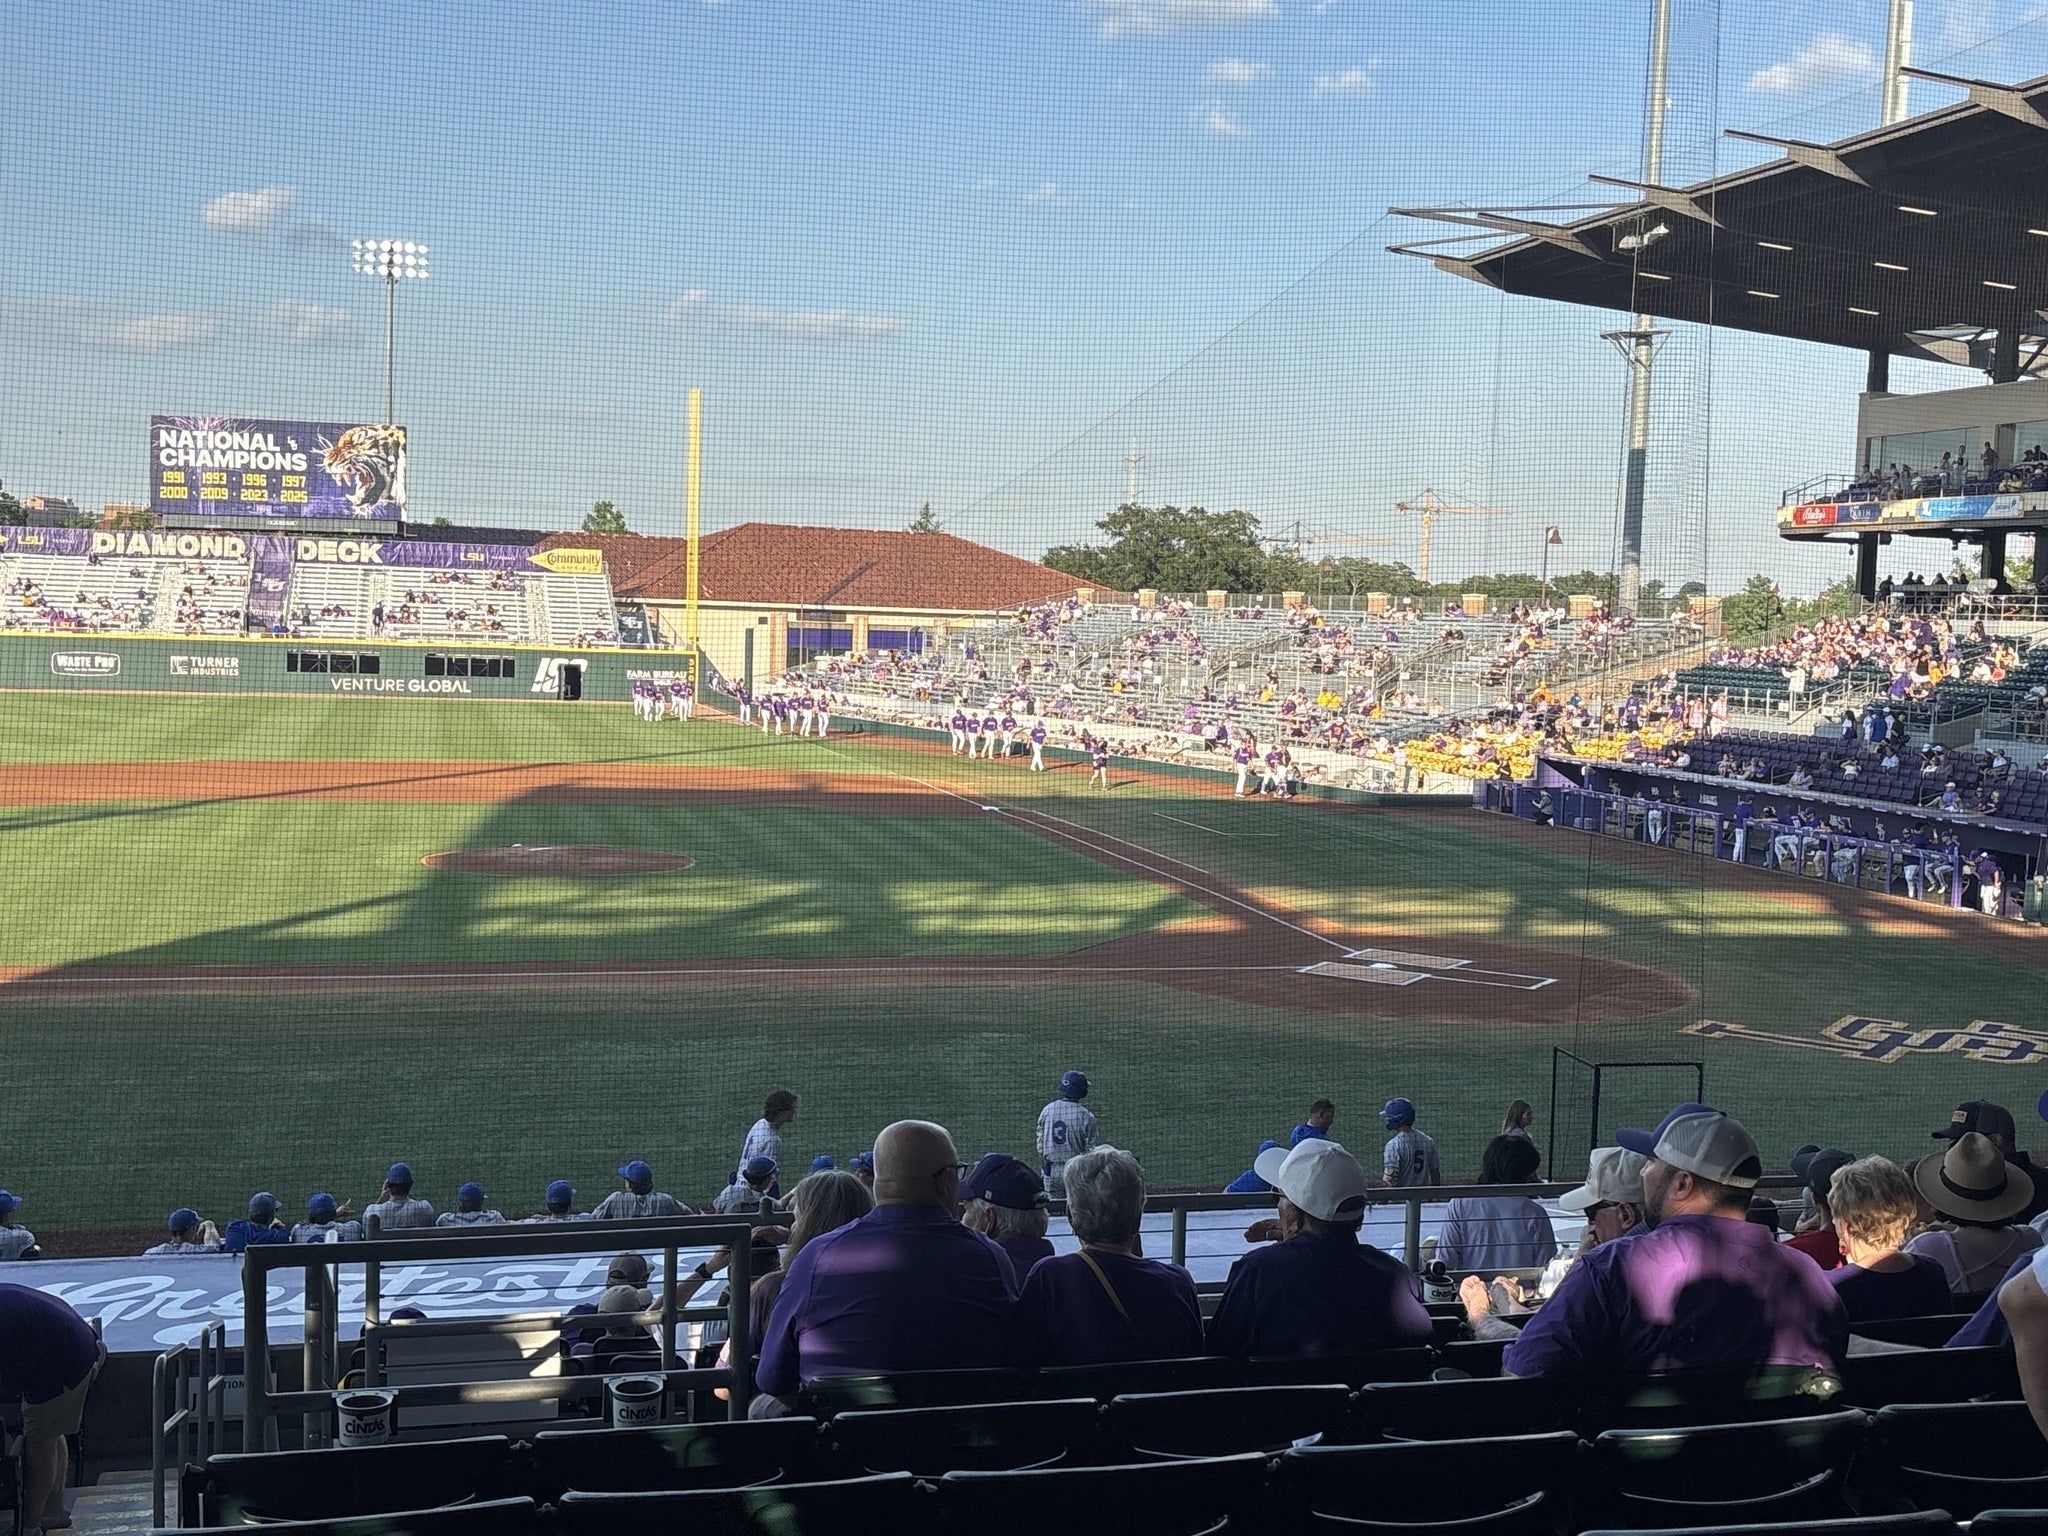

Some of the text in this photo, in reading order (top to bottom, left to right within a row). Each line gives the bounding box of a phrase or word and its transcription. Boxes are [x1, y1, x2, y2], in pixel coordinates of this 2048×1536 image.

[160, 429, 280, 452] NATIONAL
[159, 448, 308, 471] CHAMPIONS
[163, 471, 306, 488] 1991 1993 1996 1997
[160, 486, 308, 503] 2000 2009 2023 2025
[92, 531, 384, 563] DIAMOND DECK
[459, 552, 484, 562] LSU
[547, 552, 601, 567] Community
[190, 656, 239, 668] TURNER
[190, 667, 239, 676] INDUSTRIES
[627, 670, 651, 678] FARM
[331, 678, 472, 693] VENTURE GLOBAL
[1052, 1120, 1067, 1145] 3
[1413, 1149, 1425, 1174] 5
